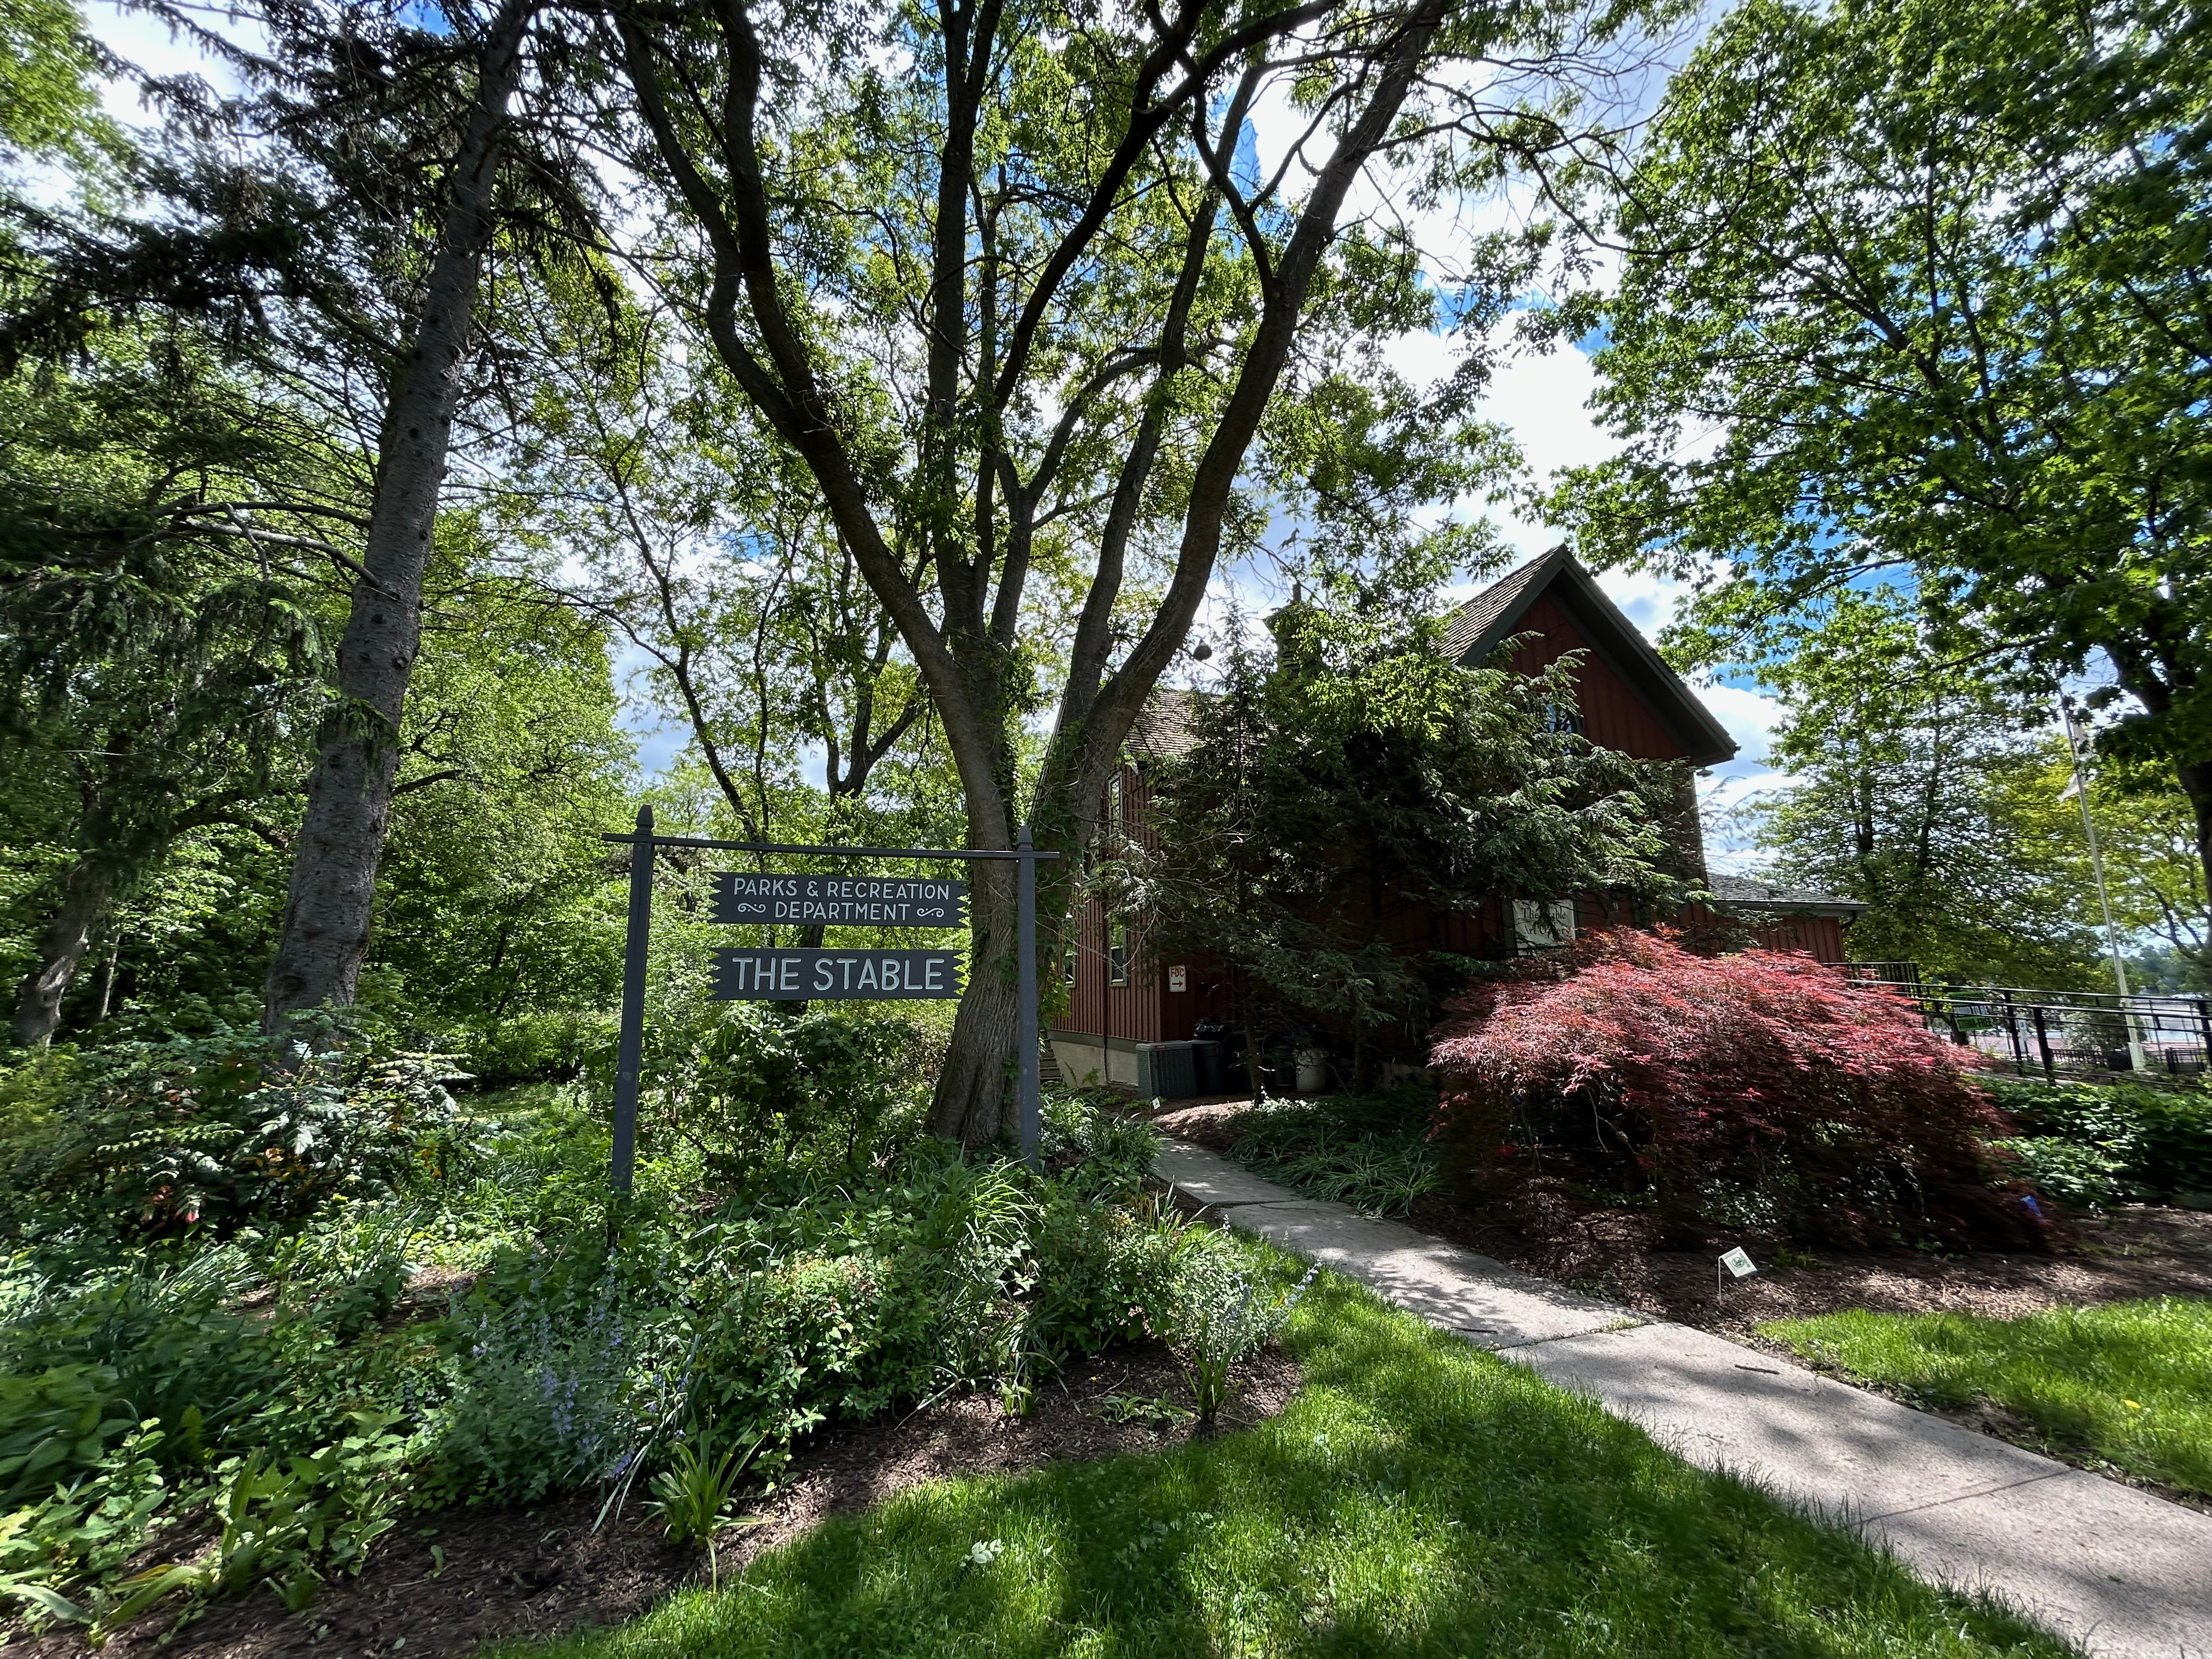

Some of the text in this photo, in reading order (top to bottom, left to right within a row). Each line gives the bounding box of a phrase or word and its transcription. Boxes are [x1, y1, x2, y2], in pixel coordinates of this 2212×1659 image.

[734, 878, 949, 900] PARKS & RECREATION
[775, 901, 910, 921] DEPARTMENT
[1521, 906, 1539, 919] The
[732, 957, 944, 991] THE STABLE
[1171, 968, 1185, 978] FDC
